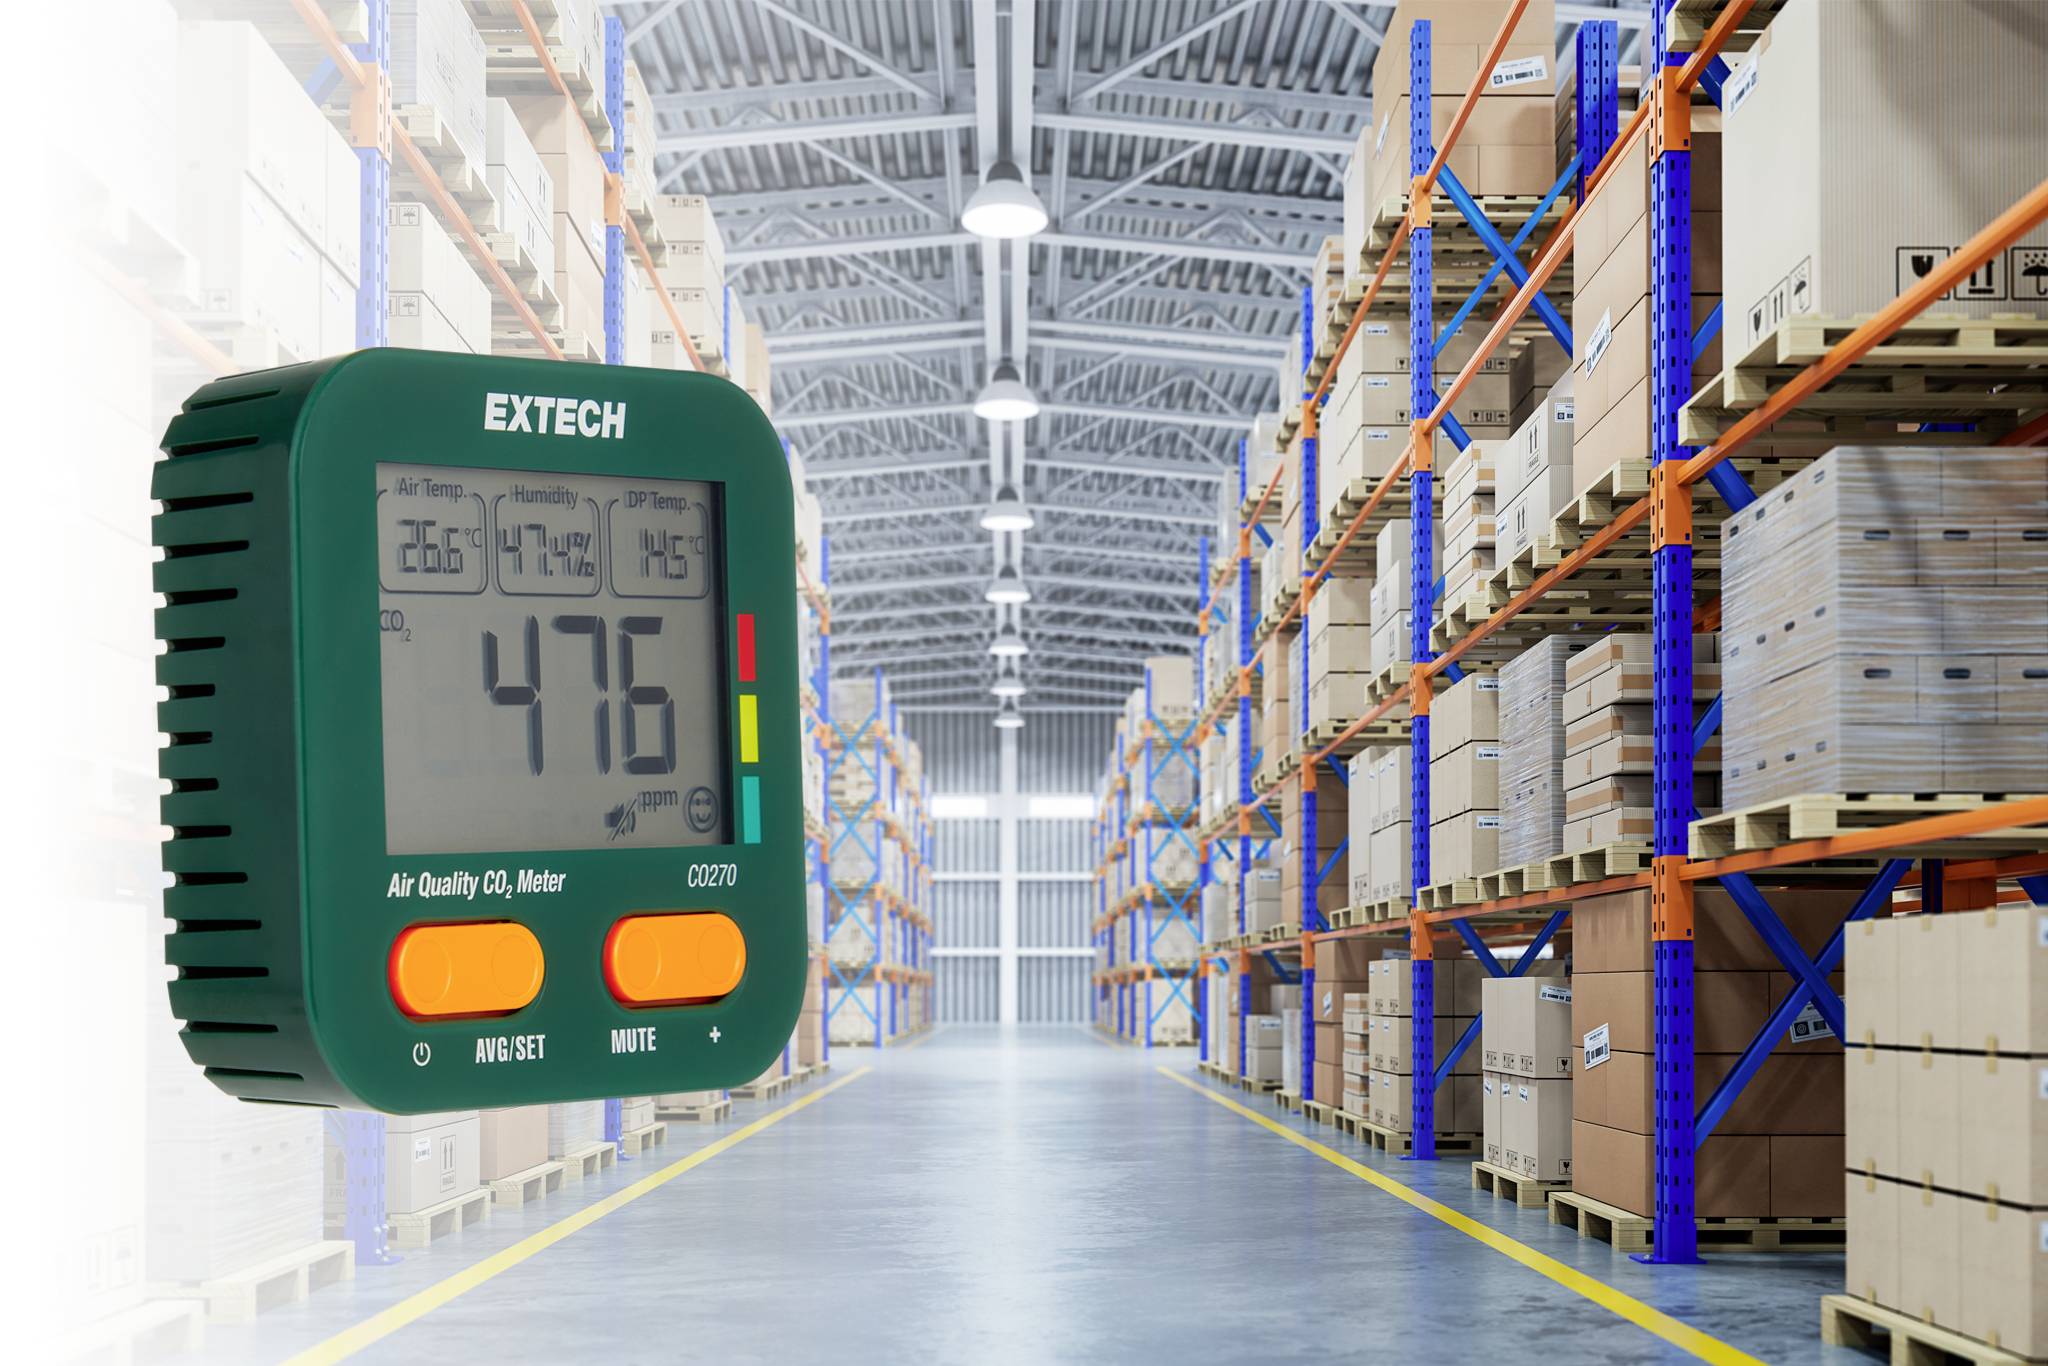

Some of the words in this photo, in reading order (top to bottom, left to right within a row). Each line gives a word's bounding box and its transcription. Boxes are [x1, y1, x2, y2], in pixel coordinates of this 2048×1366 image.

[484, 392, 627, 439] EXTECH
[397, 477, 420, 496] Air
[423, 478, 468, 503] Temp.
[513, 484, 579, 510] Humidity
[628, 490, 647, 508] DP
[650, 491, 691, 515] Temp.
[502, 523, 595, 577] 47.4%
[482, 614, 677, 776] 476
[641, 788, 678, 812] ppm
[387, 871, 415, 898] Air
[418, 871, 479, 900] Quality
[516, 868, 567, 894] Meter
[687, 863, 738, 888] CO270
[475, 1033, 546, 1063] AVG/SET
[610, 1026, 657, 1054] MUTE
